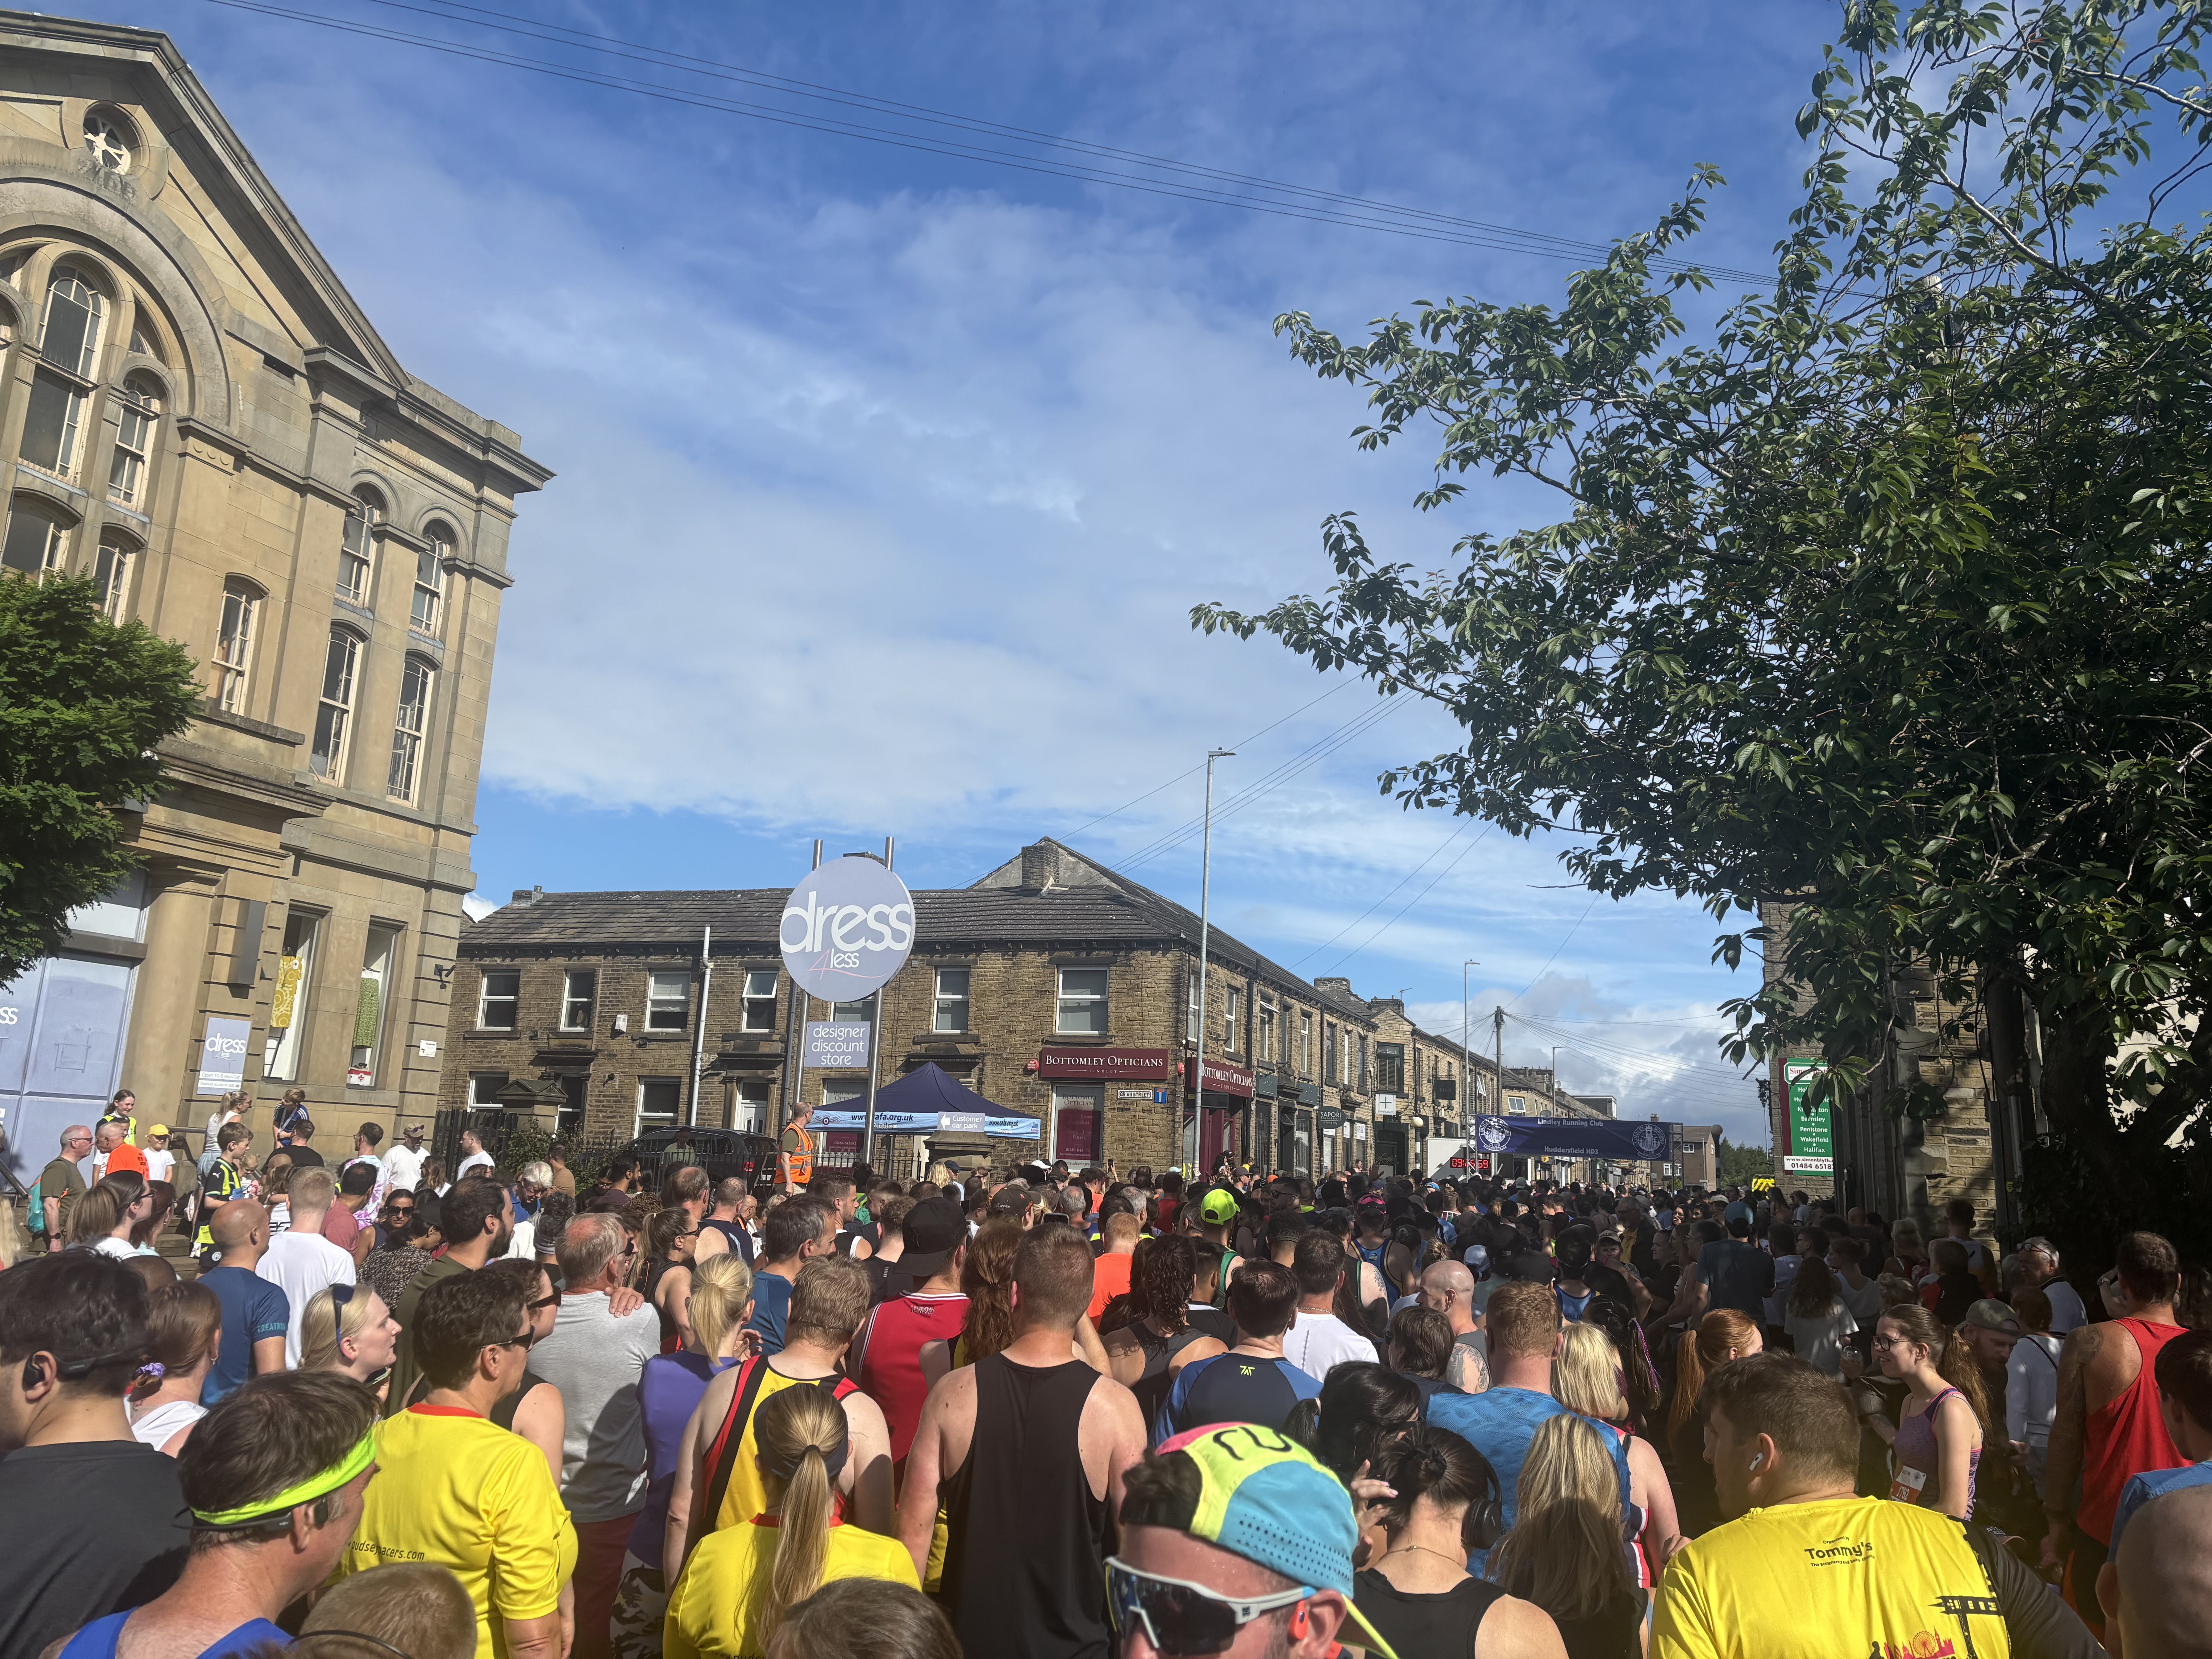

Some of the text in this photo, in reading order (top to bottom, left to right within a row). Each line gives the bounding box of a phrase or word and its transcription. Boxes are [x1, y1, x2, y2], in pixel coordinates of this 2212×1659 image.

[780, 891, 911, 953] dress
[813, 1025, 865, 1040] designer
[206, 1033, 246, 1054] dress
[812, 1039, 864, 1052] discount
[821, 1053, 852, 1065] store
[1046, 1055, 1105, 1066] BOTTOMLEY
[1108, 1056, 1163, 1066] OPTICIANS
[1202, 1063, 1229, 1082] BOTTOMLEY
[1230, 1070, 1252, 1087] OPTICIANS
[1804, 1542, 1873, 1559] Tommy's
